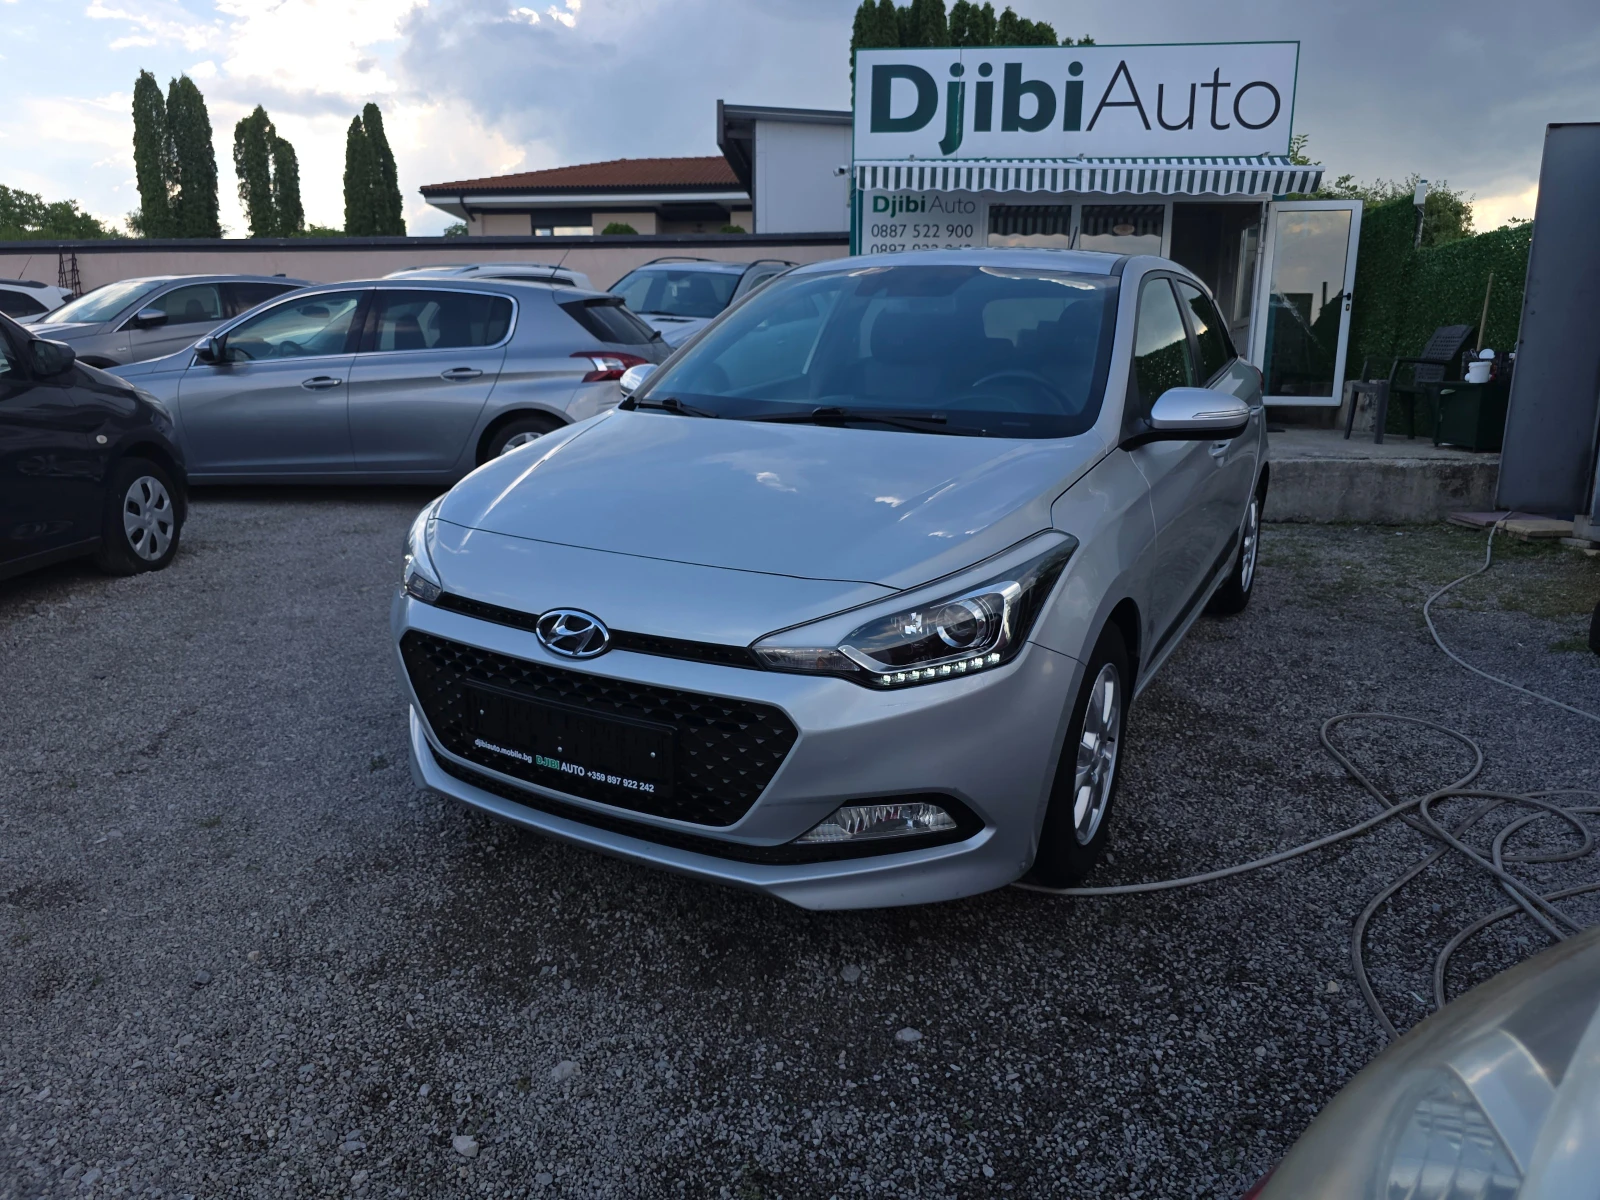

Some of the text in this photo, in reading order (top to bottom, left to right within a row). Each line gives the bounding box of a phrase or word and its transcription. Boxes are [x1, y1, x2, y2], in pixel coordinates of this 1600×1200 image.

[871, 224, 973, 238] 0887 522 900
[474, 739, 655, 793] djibiauto.mobile.bg DJIBI AUTO +359 897 922 242
